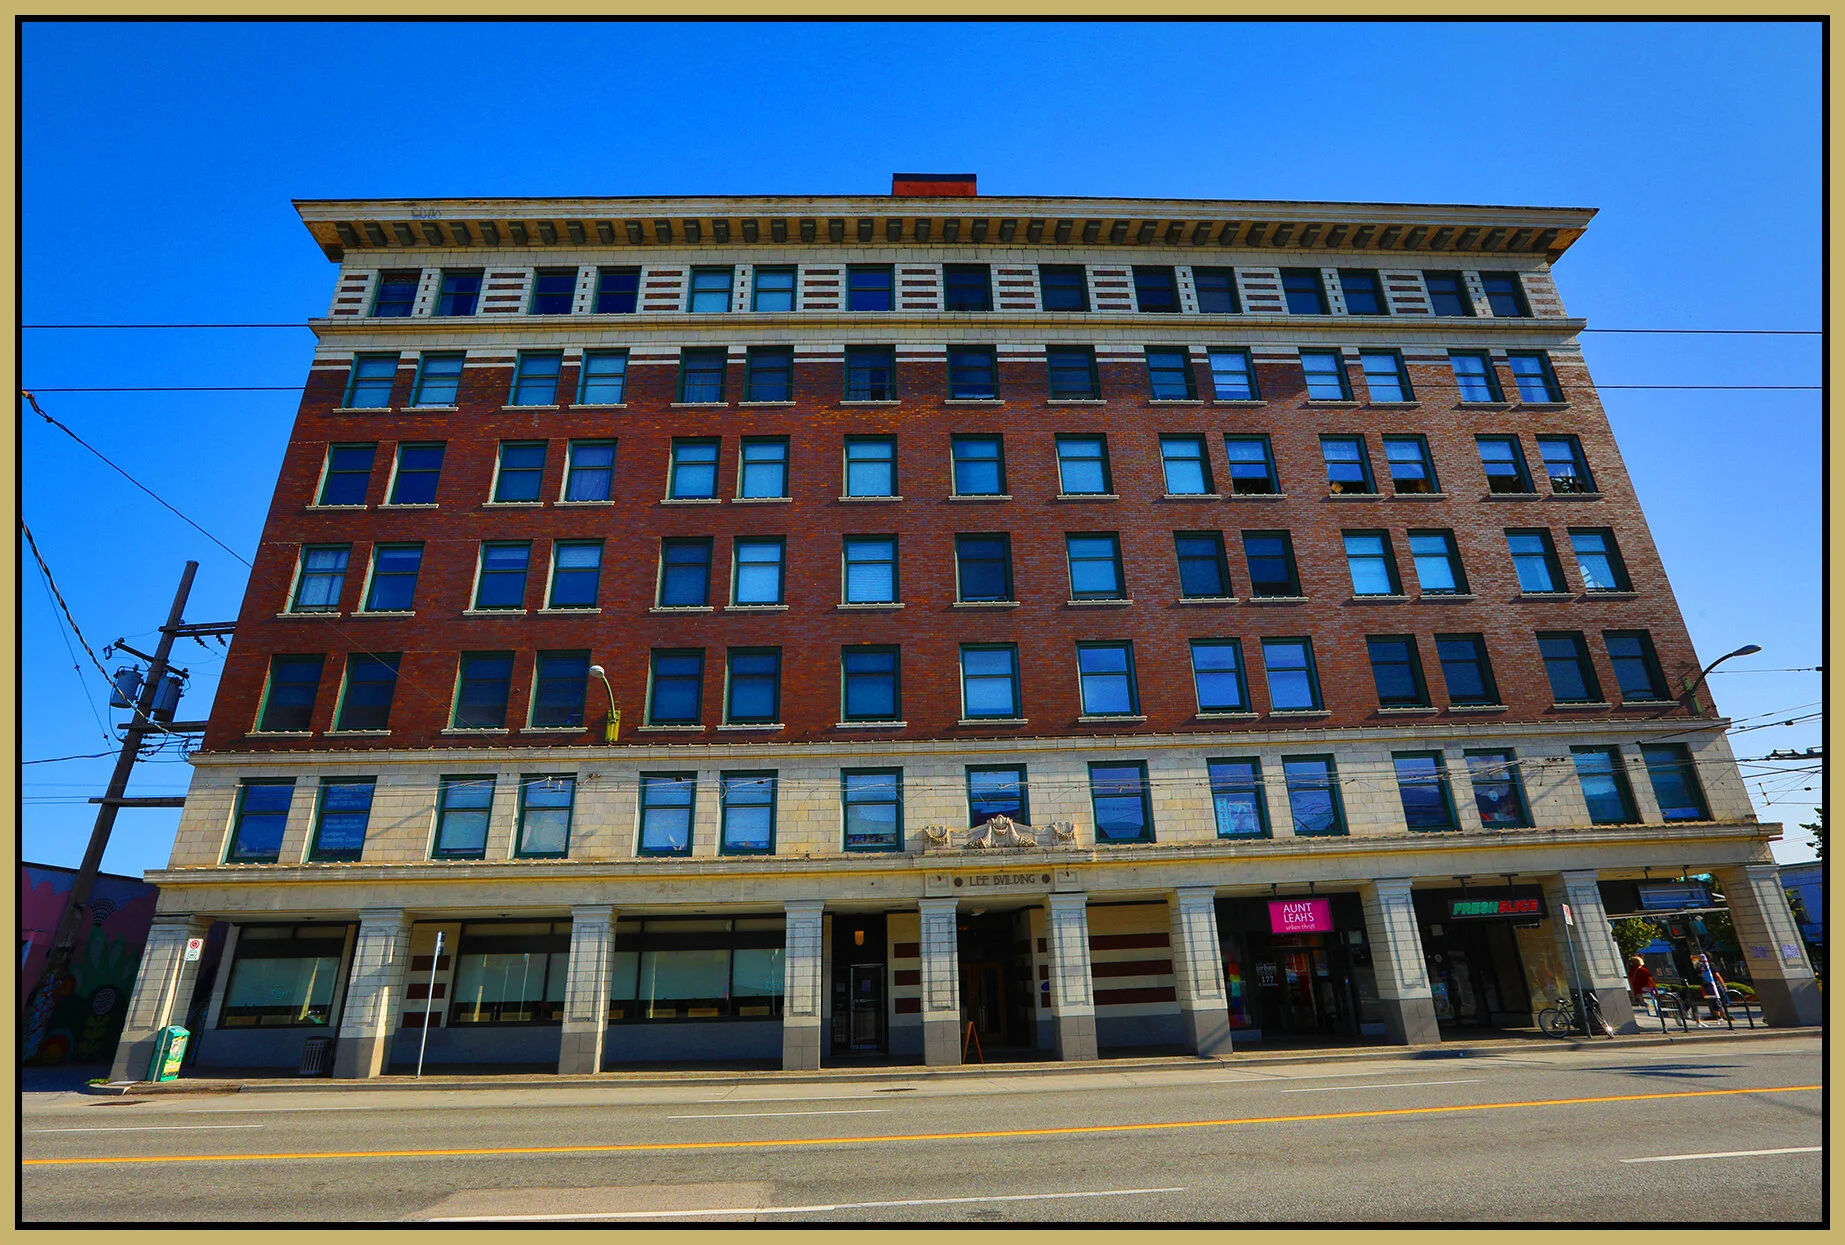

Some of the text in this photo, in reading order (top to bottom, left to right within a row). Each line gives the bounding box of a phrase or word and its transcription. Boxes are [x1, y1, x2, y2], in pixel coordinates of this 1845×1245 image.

[969, 875, 989, 887] LEE
[1283, 902, 1312, 913] AUNT
[1283, 912, 1315, 923] LEAH'S
[1301, 922, 1316, 930] thrift
[1261, 975, 1275, 983] 177
